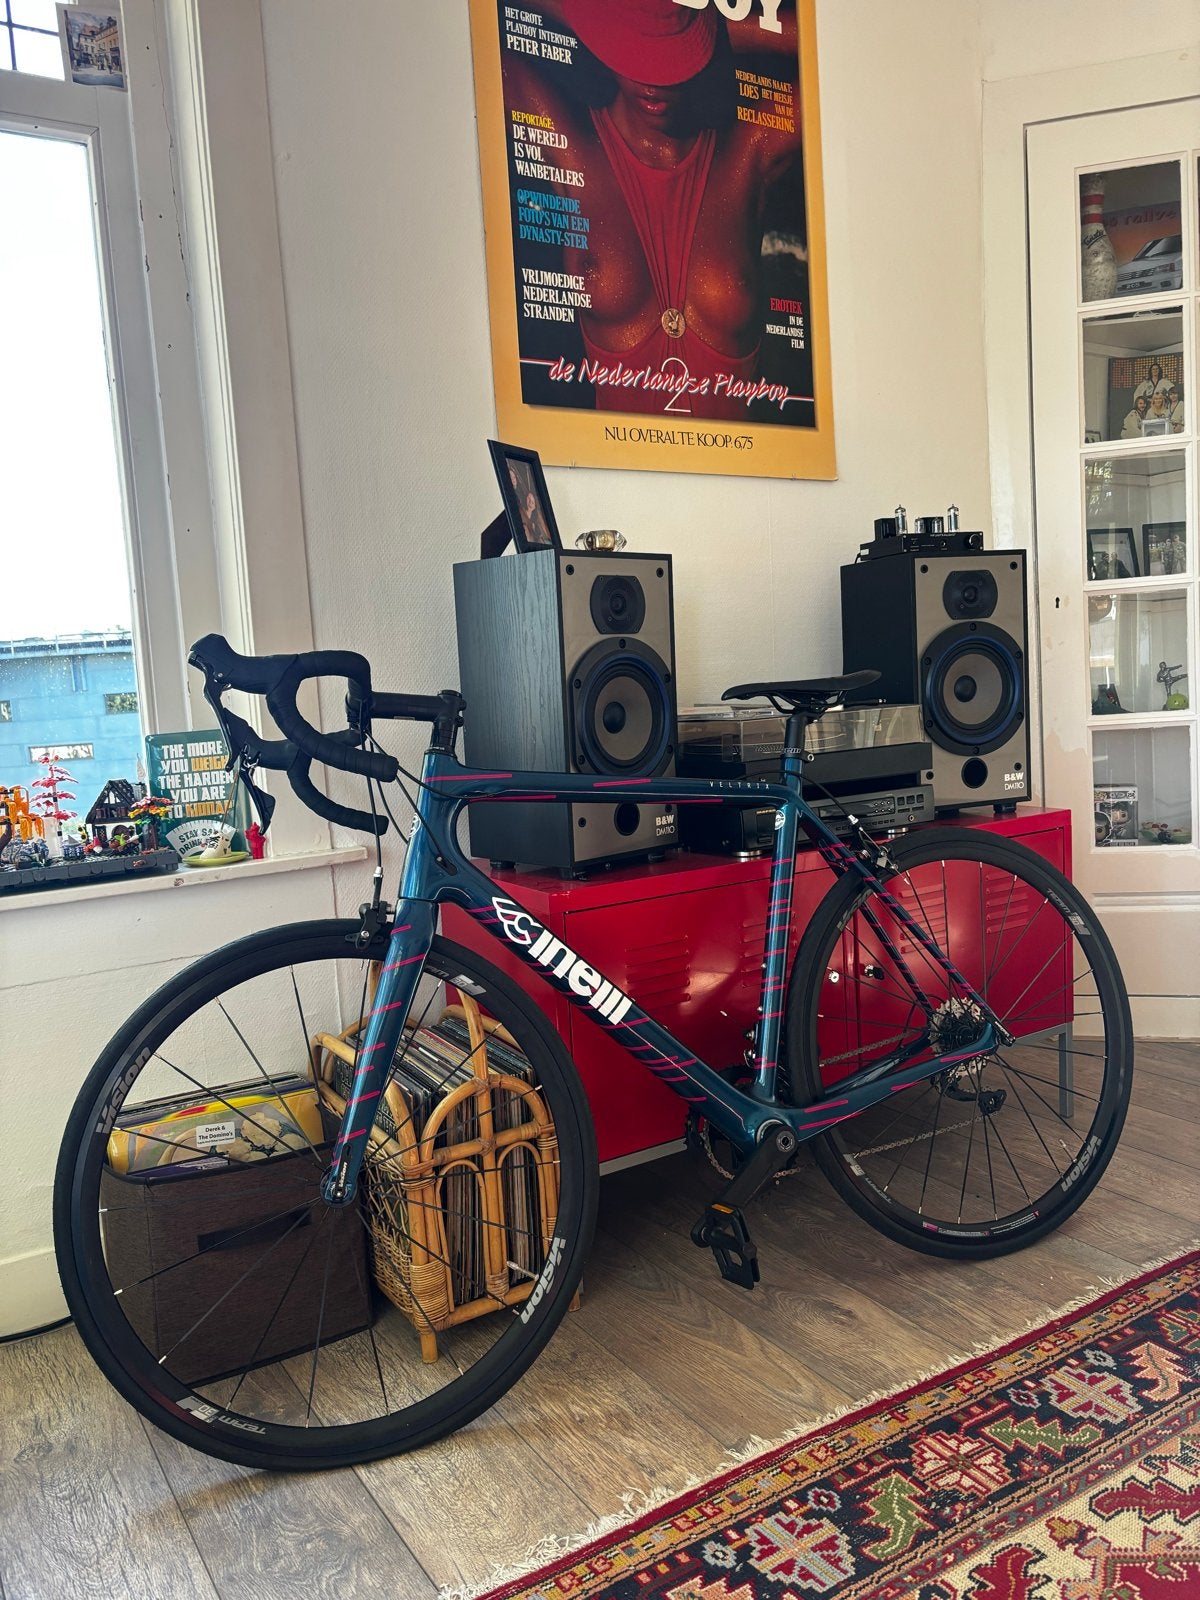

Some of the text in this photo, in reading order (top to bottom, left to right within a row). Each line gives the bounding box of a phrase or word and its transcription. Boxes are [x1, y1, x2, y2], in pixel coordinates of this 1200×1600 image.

[505, 6, 543, 26] HET GROTE
[506, 20, 578, 49] PLAYBOY INTERVIEW:
[506, 34, 573, 65] PETER FABER
[735, 69, 793, 94] NEDERLANDS NAAKT:
[739, 82, 794, 106] LOES HET MEISJE
[511, 110, 554, 129] REPORTAGE:
[736, 105, 795, 133] RECLASSERING
[774, 103, 794, 118] VAN DE
[513, 123, 568, 150] DE WERELD
[514, 141, 544, 162] IS VOL
[515, 159, 585, 188] WANBETALERS
[517, 188, 581, 214] OPWINDENDE
[518, 206, 590, 234] FOTO'S VAN EEN
[519, 224, 589, 250] DYNASTY-STER
[522, 267, 586, 291] VRIJMOEDIGE
[523, 285, 592, 309] NEDERLANDSE
[770, 297, 803, 315] EROTIEK
[523, 302, 575, 323] STRANDEN
[789, 315, 804, 327] IN DE
[765, 323, 805, 338] NEDERLANDSE
[791, 338, 805, 350] FILM
[549, 356, 790, 411] de Nederlandse Playboy
[604, 426, 628, 442] NU
[161, 740, 223, 760] THE MORE
[160, 758, 189, 775] YOU
[158, 772, 182, 790] THE
[709, 780, 770, 790] VELTRIX
[1004, 772, 1024, 782] B&W
[170, 785, 226, 804] YOU ARE
[166, 803, 183, 819] TO
[655, 814, 675, 827] B&W
[178, 828, 198, 844] STAY
[205, 1125, 221, 1133] Derek
